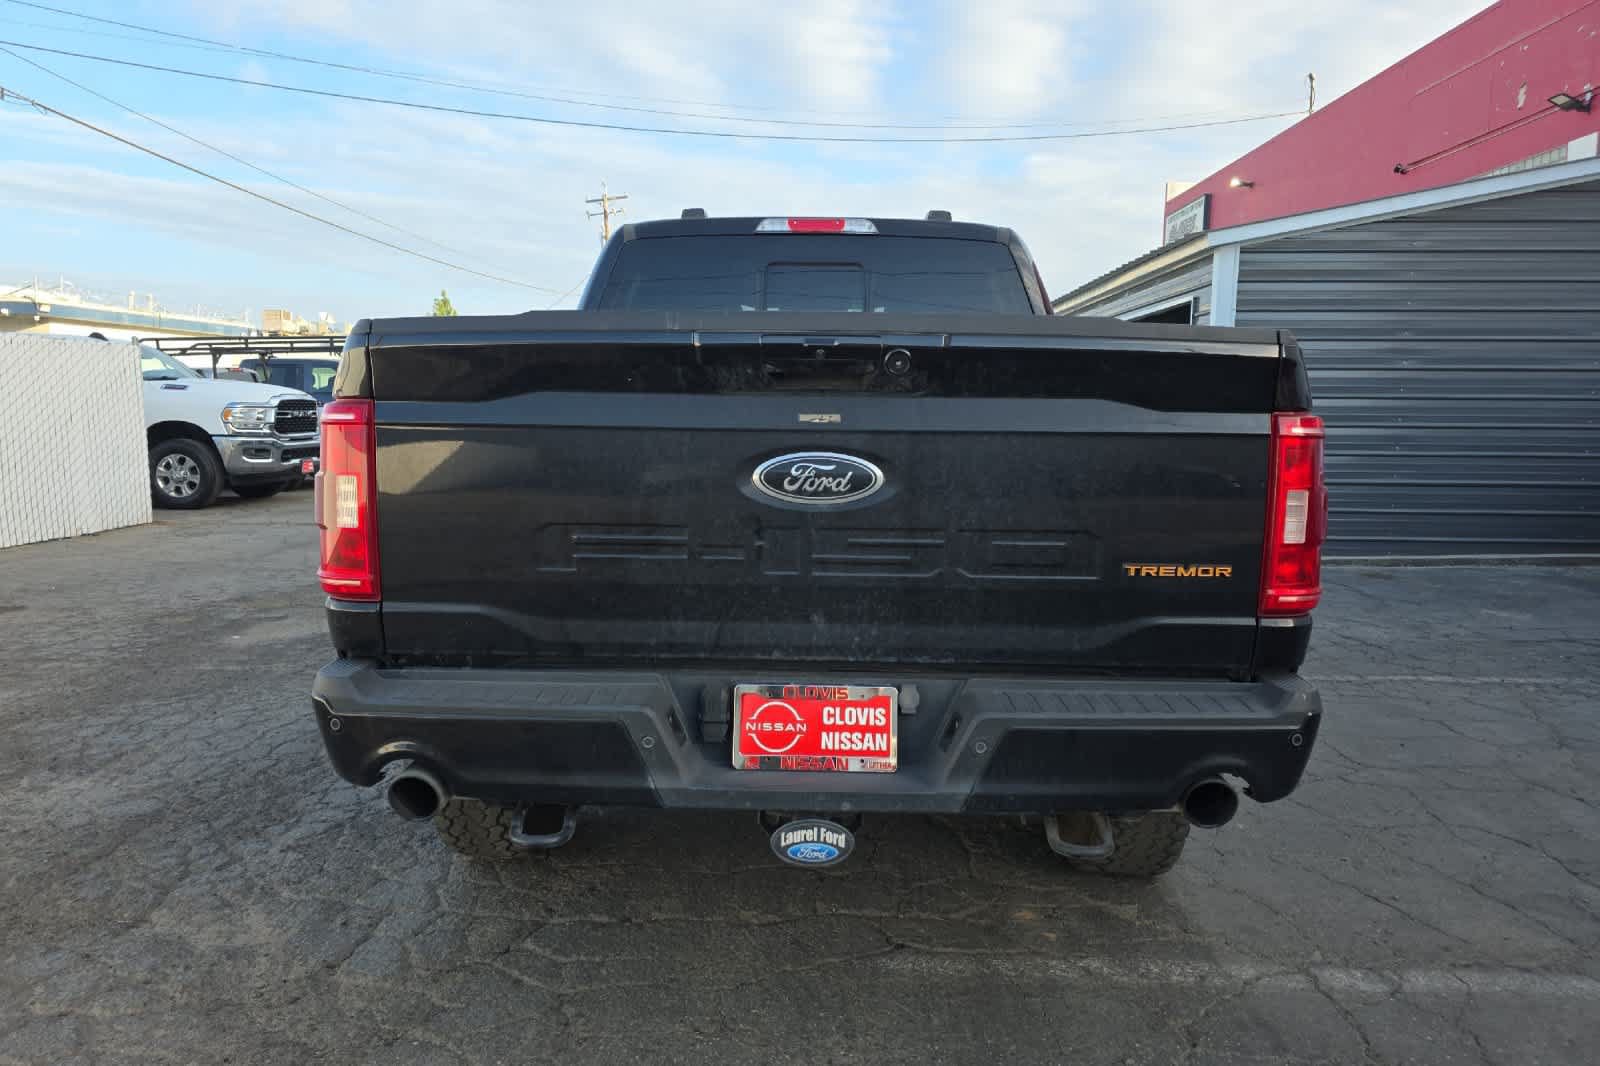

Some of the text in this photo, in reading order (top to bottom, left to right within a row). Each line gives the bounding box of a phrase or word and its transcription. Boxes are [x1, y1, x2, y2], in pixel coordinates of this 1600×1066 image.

[783, 463, 853, 492] Ford
[1124, 564, 1233, 578] TREMOR
[783, 686, 849, 700] CLOVIS
[822, 706, 887, 726] CLOVIS
[745, 722, 807, 733] NISSAN
[820, 732, 888, 752] NISSAN
[780, 757, 849, 771] NISSAN
[781, 826, 846, 848] Laurel Ford
[797, 847, 829, 859] Ford
